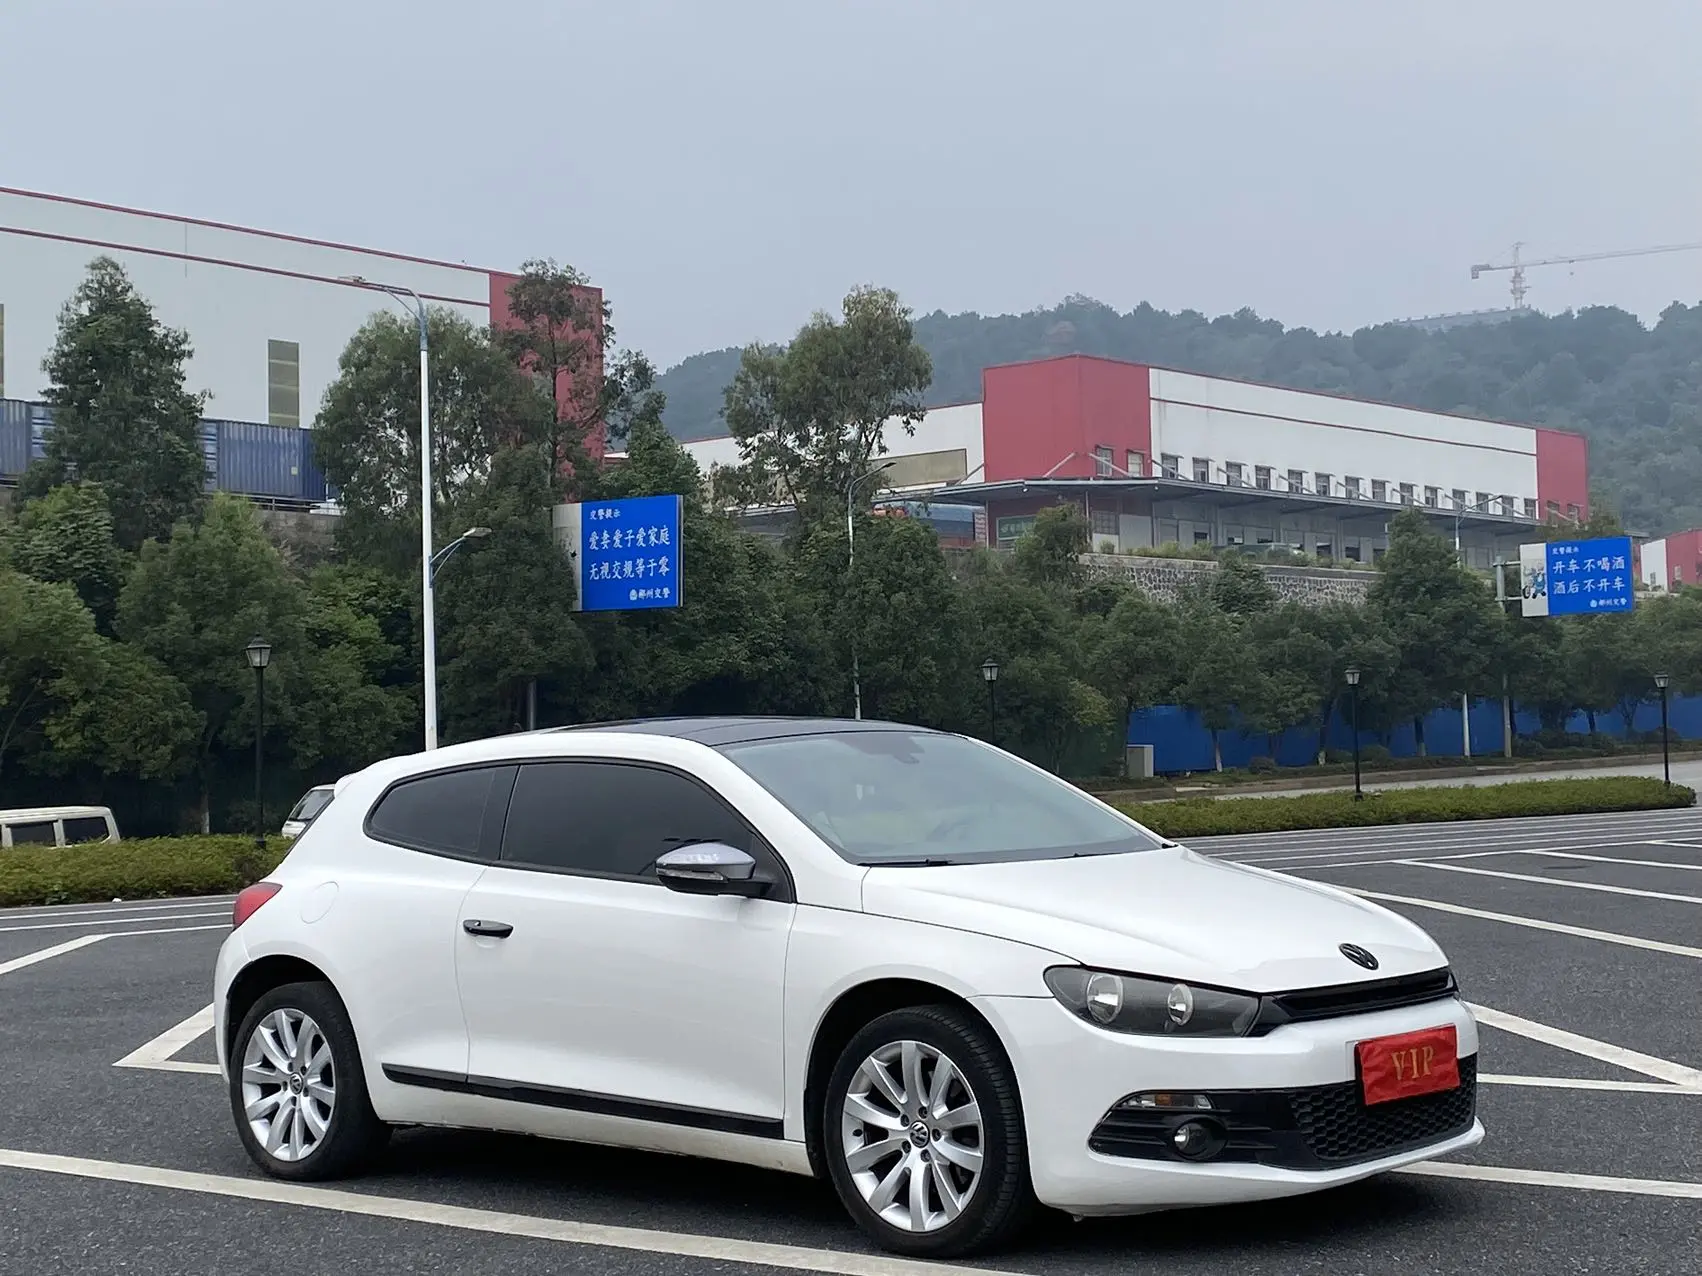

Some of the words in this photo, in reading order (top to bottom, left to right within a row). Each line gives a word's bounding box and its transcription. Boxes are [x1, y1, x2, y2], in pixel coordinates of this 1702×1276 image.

[588, 524, 671, 551] 爱妻爱子爱家庭
[589, 555, 671, 581] 无视交规等于零
[1390, 1045, 1434, 1081] VIP
